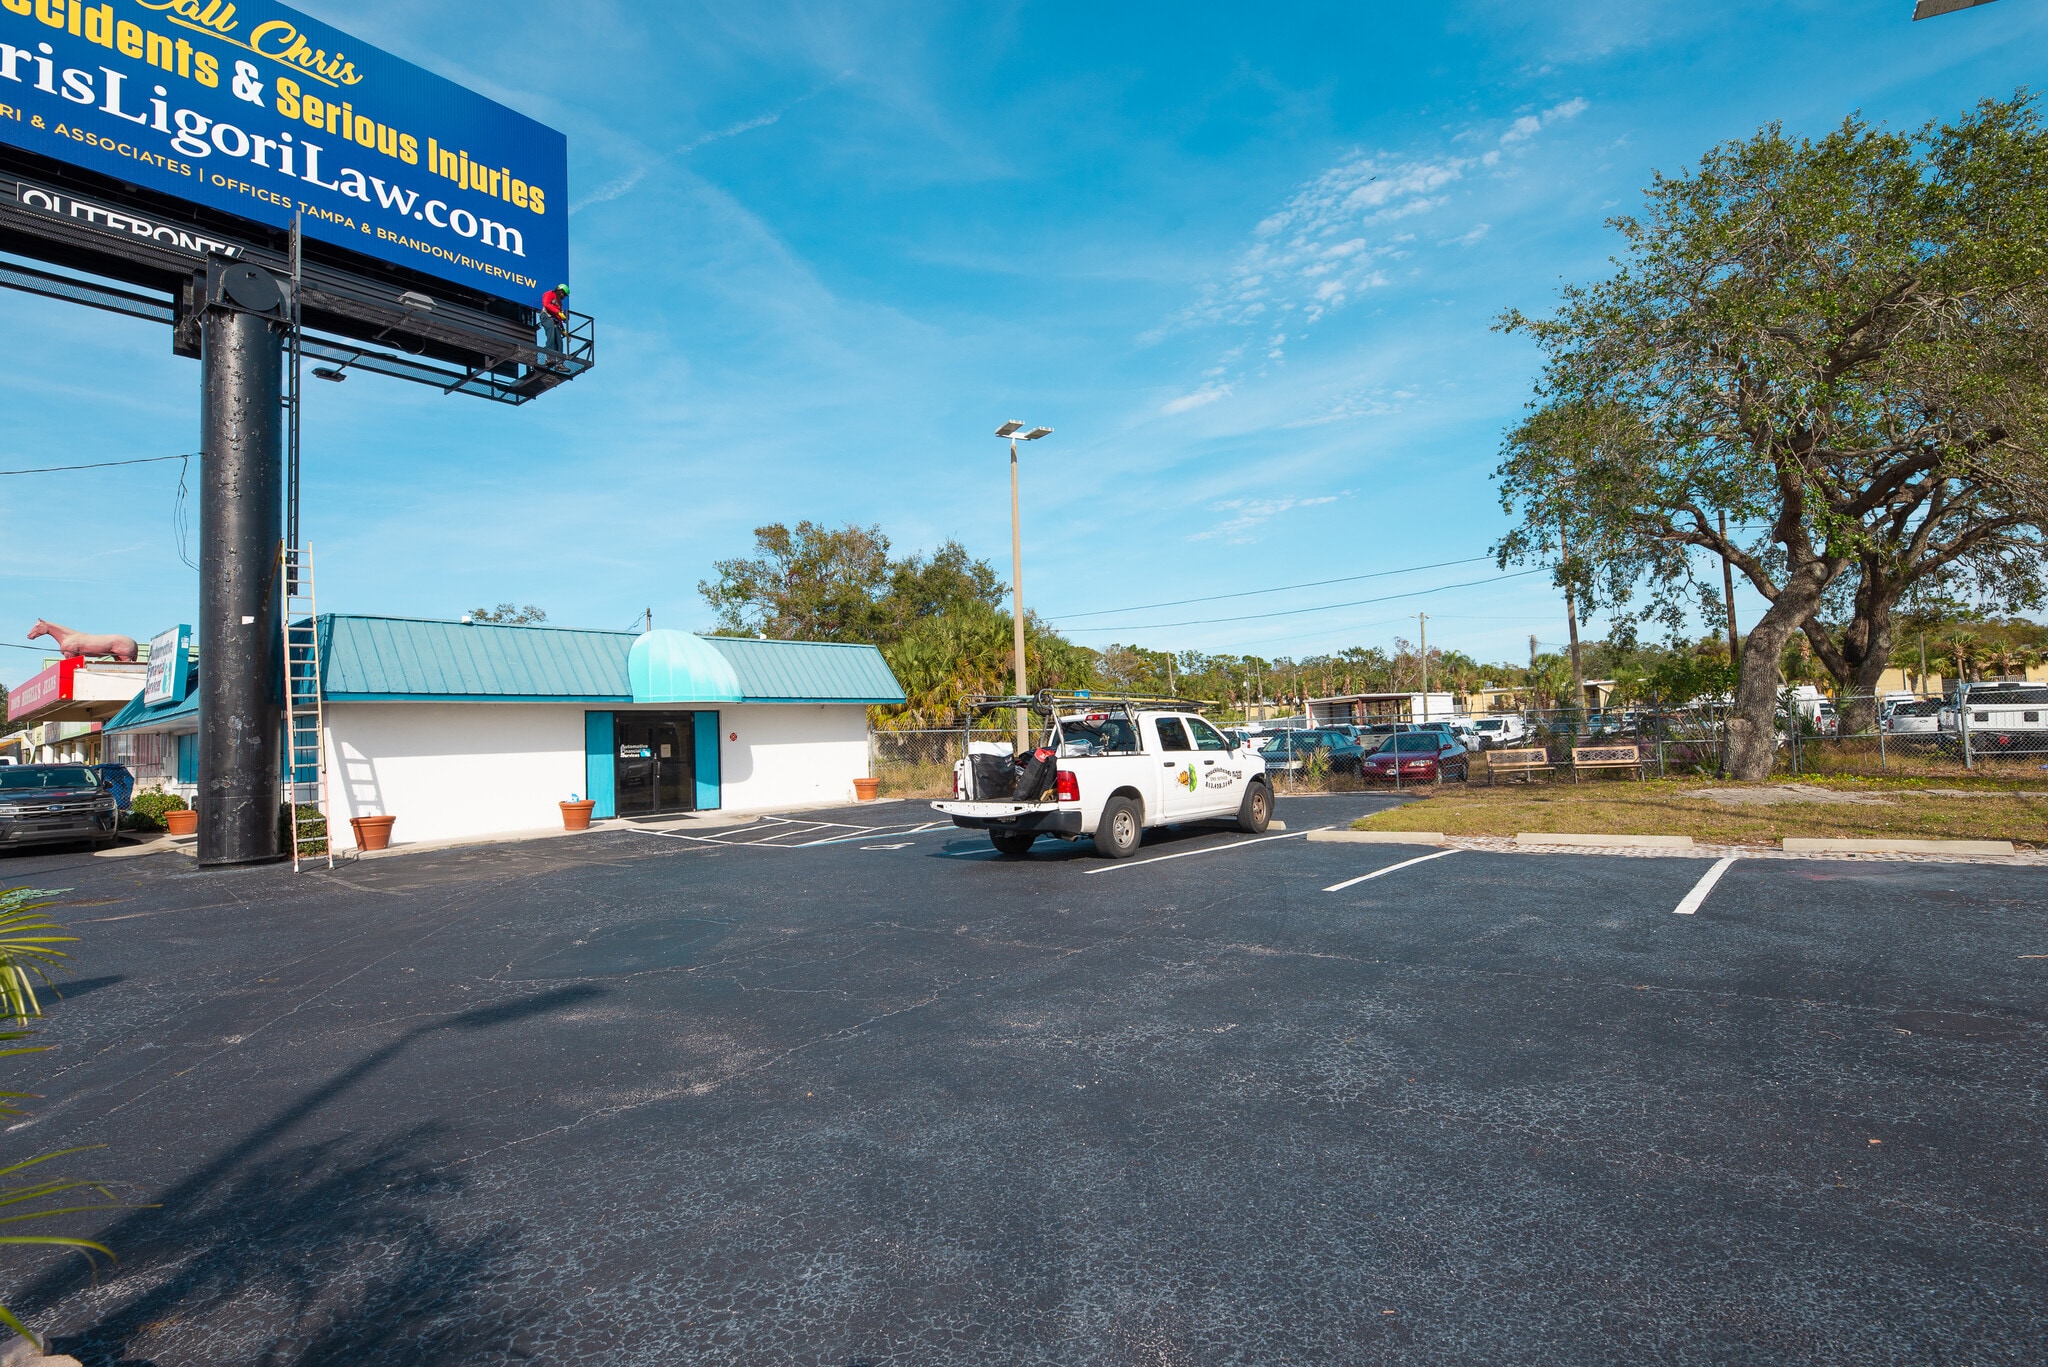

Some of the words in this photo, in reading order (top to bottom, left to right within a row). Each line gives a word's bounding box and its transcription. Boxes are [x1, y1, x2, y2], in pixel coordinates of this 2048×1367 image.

[250, 20, 363, 85] Chris
[0, 42, 526, 258] risLigoriLaw.com
[30, 115, 46, 129] &
[54, 123, 192, 176] ASSOCIATES
[211, 174, 292, 209] OFFICES
[298, 201, 356, 230] TAMPA
[361, 222, 372, 235] &
[377, 227, 537, 288] BRANDON/RIVERVIEW
[232, 60, 265, 108] &
[276, 76, 418, 166] Serious
[428, 136, 545, 215] Injuries
